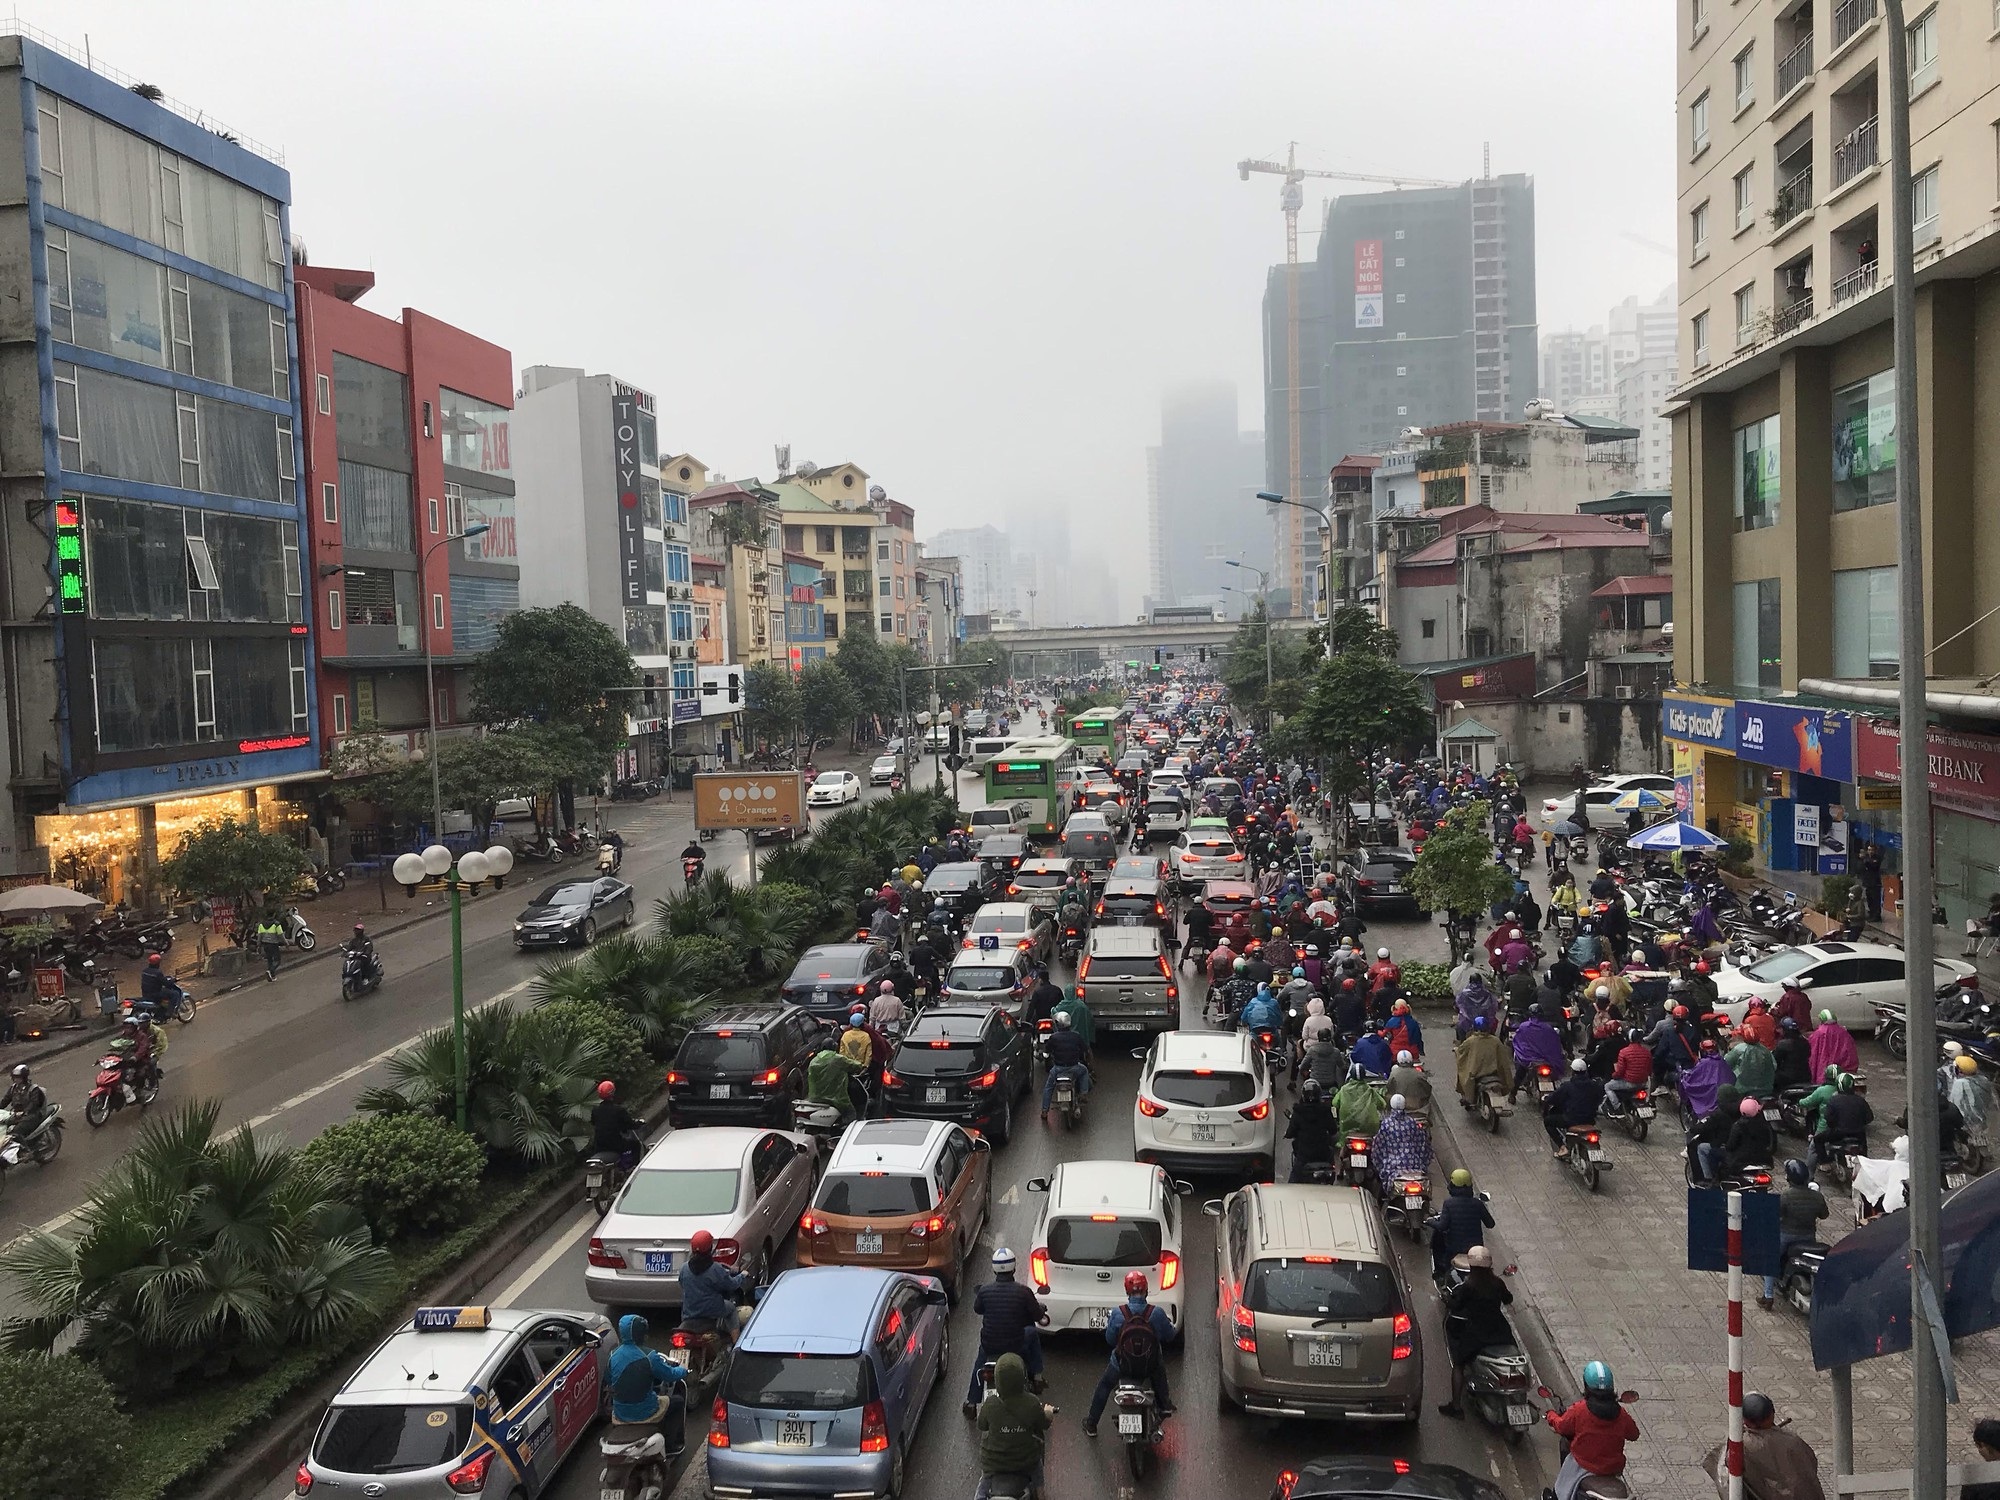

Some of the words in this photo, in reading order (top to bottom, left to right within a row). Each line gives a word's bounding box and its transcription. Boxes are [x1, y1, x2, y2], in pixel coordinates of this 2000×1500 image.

[1359, 257, 1379, 270] CẤT
[1359, 270, 1380, 283] NÓC
[1669, 708, 1687, 732] Kids
[1688, 711, 1714, 738] plaza
[177, 760, 239, 783] ITALY
[1928, 754, 1984, 784] RIBANK
[719, 801, 730, 815] 4
[735, 802, 778, 815] Oranges
[862, 1234, 877, 1243] 30E
[651, 1254, 666, 1263] 80A
[1316, 1343, 1333, 1354] 30E
[1310, 1354, 1341, 1367] 331.45
[785, 1421, 805, 1433] 30V
[783, 1433, 806, 1445] 1755
